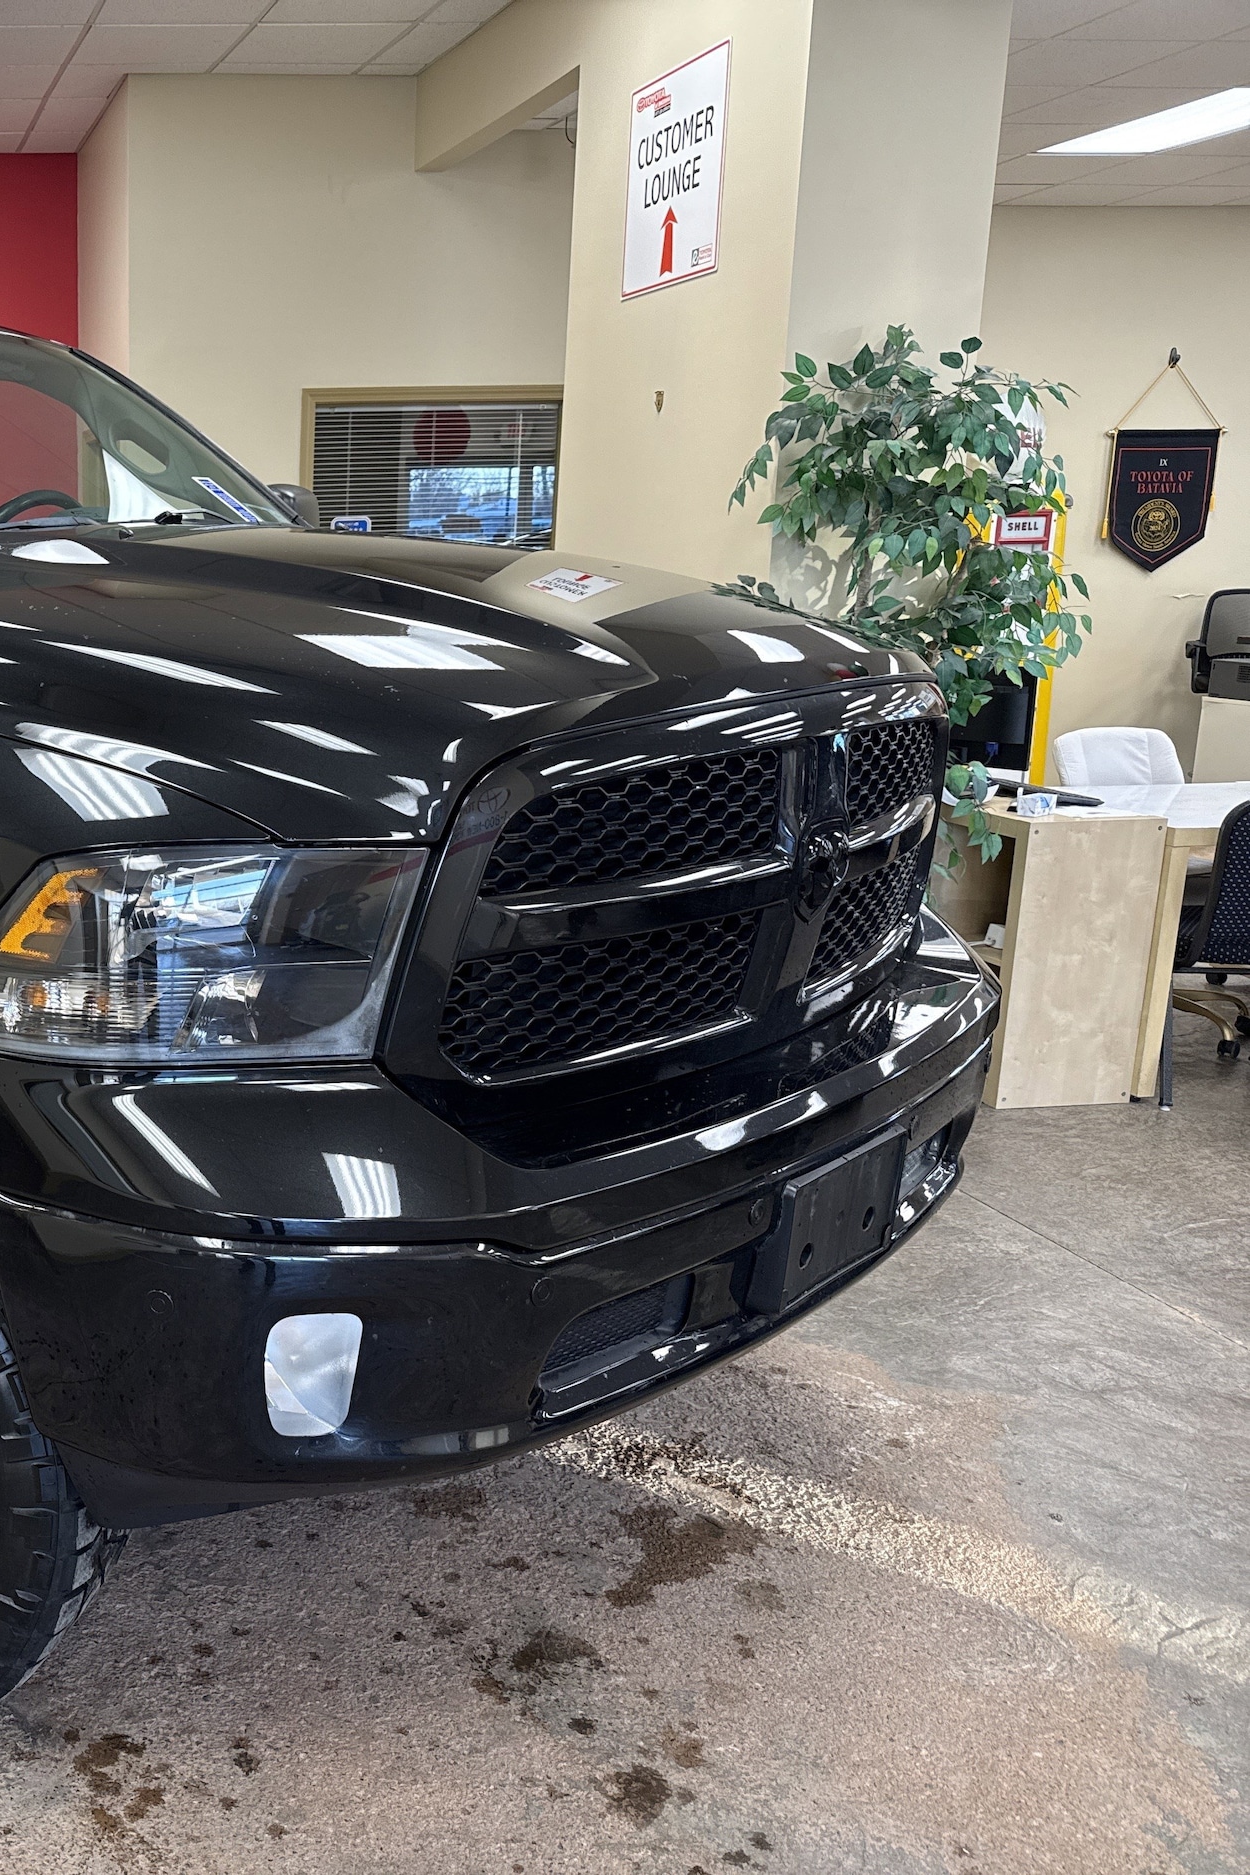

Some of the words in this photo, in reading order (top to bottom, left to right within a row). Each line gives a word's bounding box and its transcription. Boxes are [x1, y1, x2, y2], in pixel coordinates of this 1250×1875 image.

[637, 105, 714, 170] CUSTOMER
[644, 154, 702, 209] LOUNGE
[1159, 458, 1169, 467] IX
[1130, 470, 1174, 482] TOYOTA
[1178, 470, 1195, 482] OF
[1136, 482, 1183, 494] BATAVIA
[1007, 521, 1040, 532] SHELL
